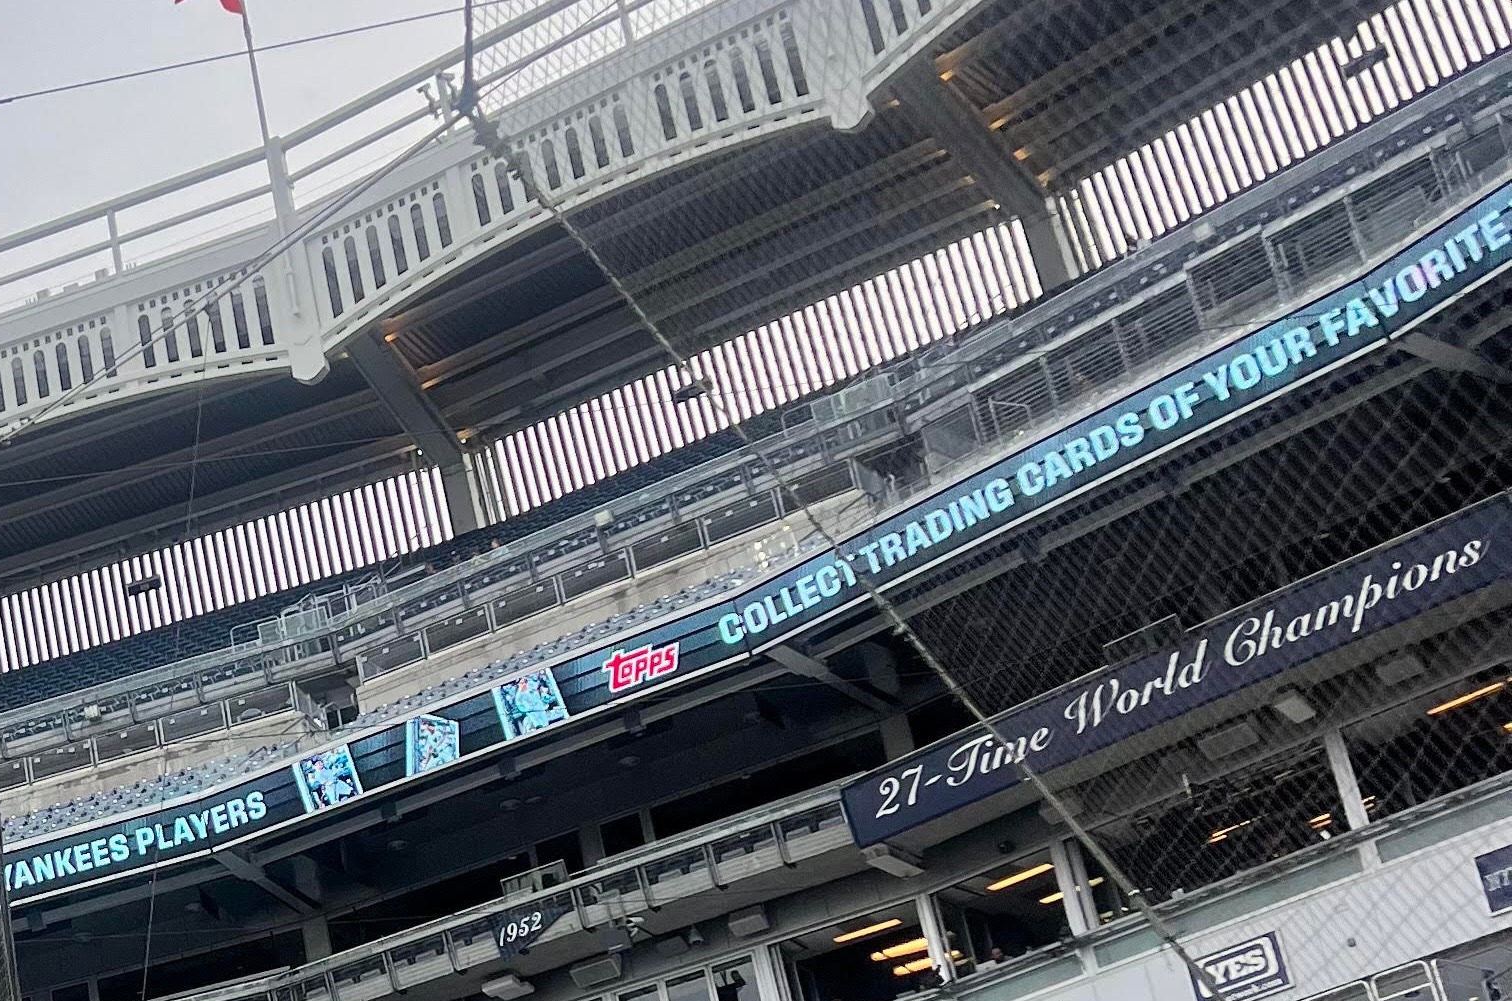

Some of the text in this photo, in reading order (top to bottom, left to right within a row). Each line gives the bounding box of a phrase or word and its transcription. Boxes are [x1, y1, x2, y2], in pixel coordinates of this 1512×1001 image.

[717, 209, 1512, 645] COLLECT TRADING CARDS OF YOUR FAVORITE
[874, 535, 1492, 819] 27-Time World Champions
[136, 790, 268, 856] PLAYERS
[499, 911, 543, 947] 1952
[1204, 947, 1266, 985] YES
